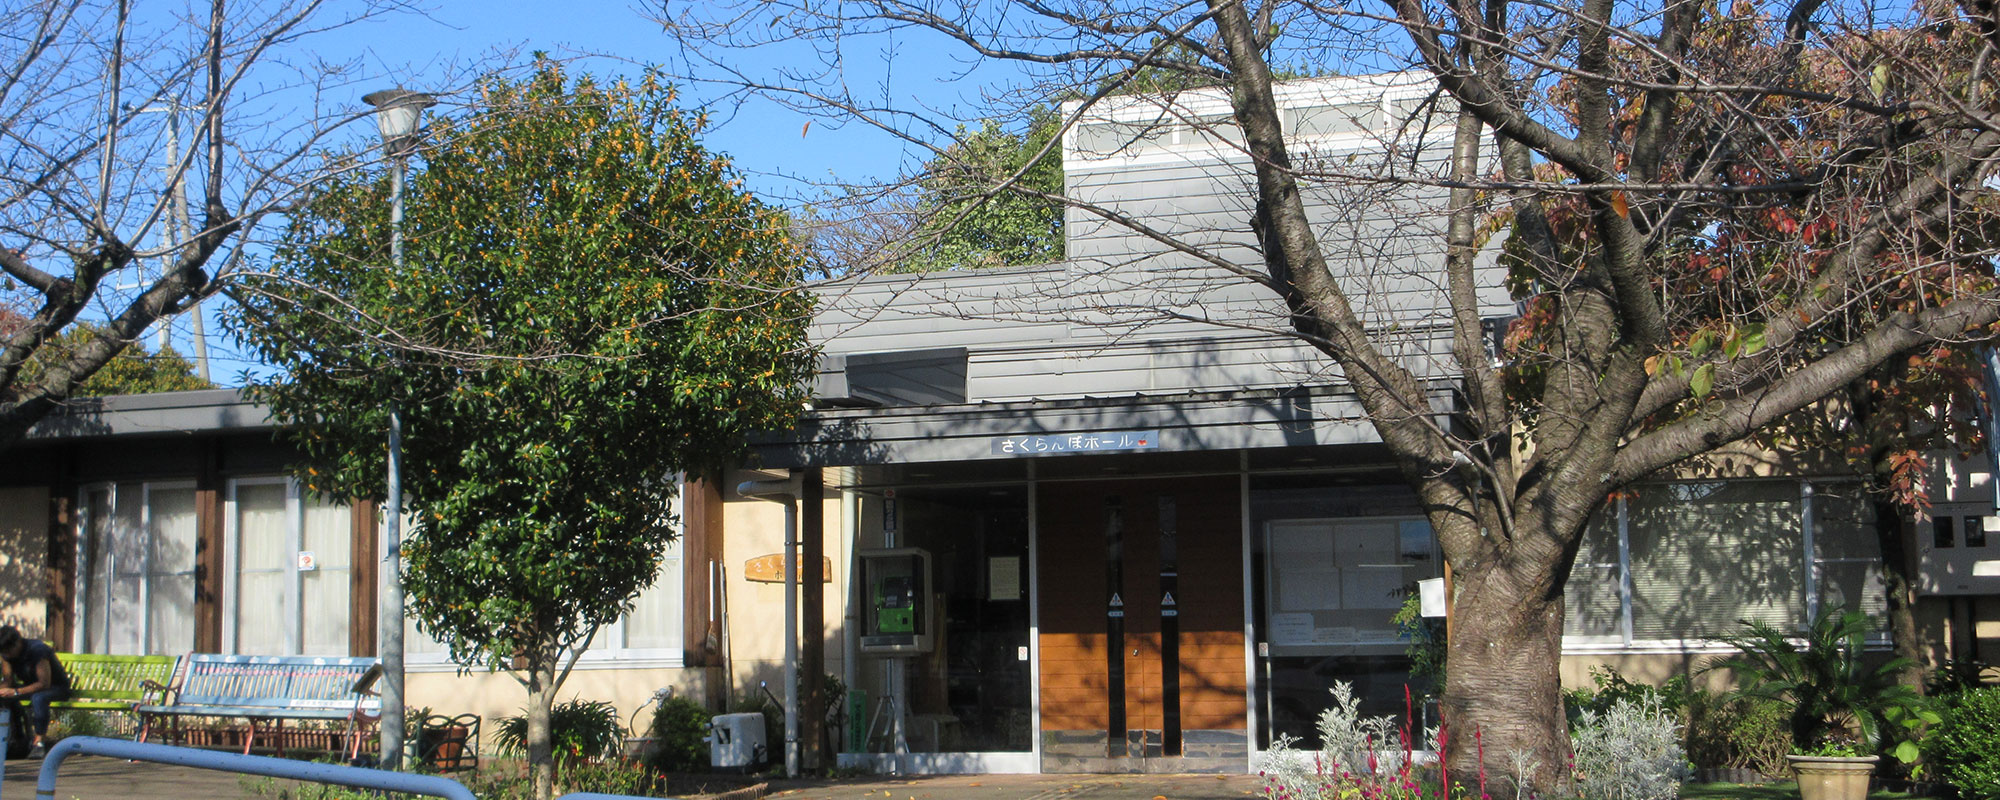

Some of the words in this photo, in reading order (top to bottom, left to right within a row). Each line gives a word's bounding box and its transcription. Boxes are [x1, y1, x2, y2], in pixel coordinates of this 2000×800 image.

[1002, 434, 1133, 453] さくらんぼホール
